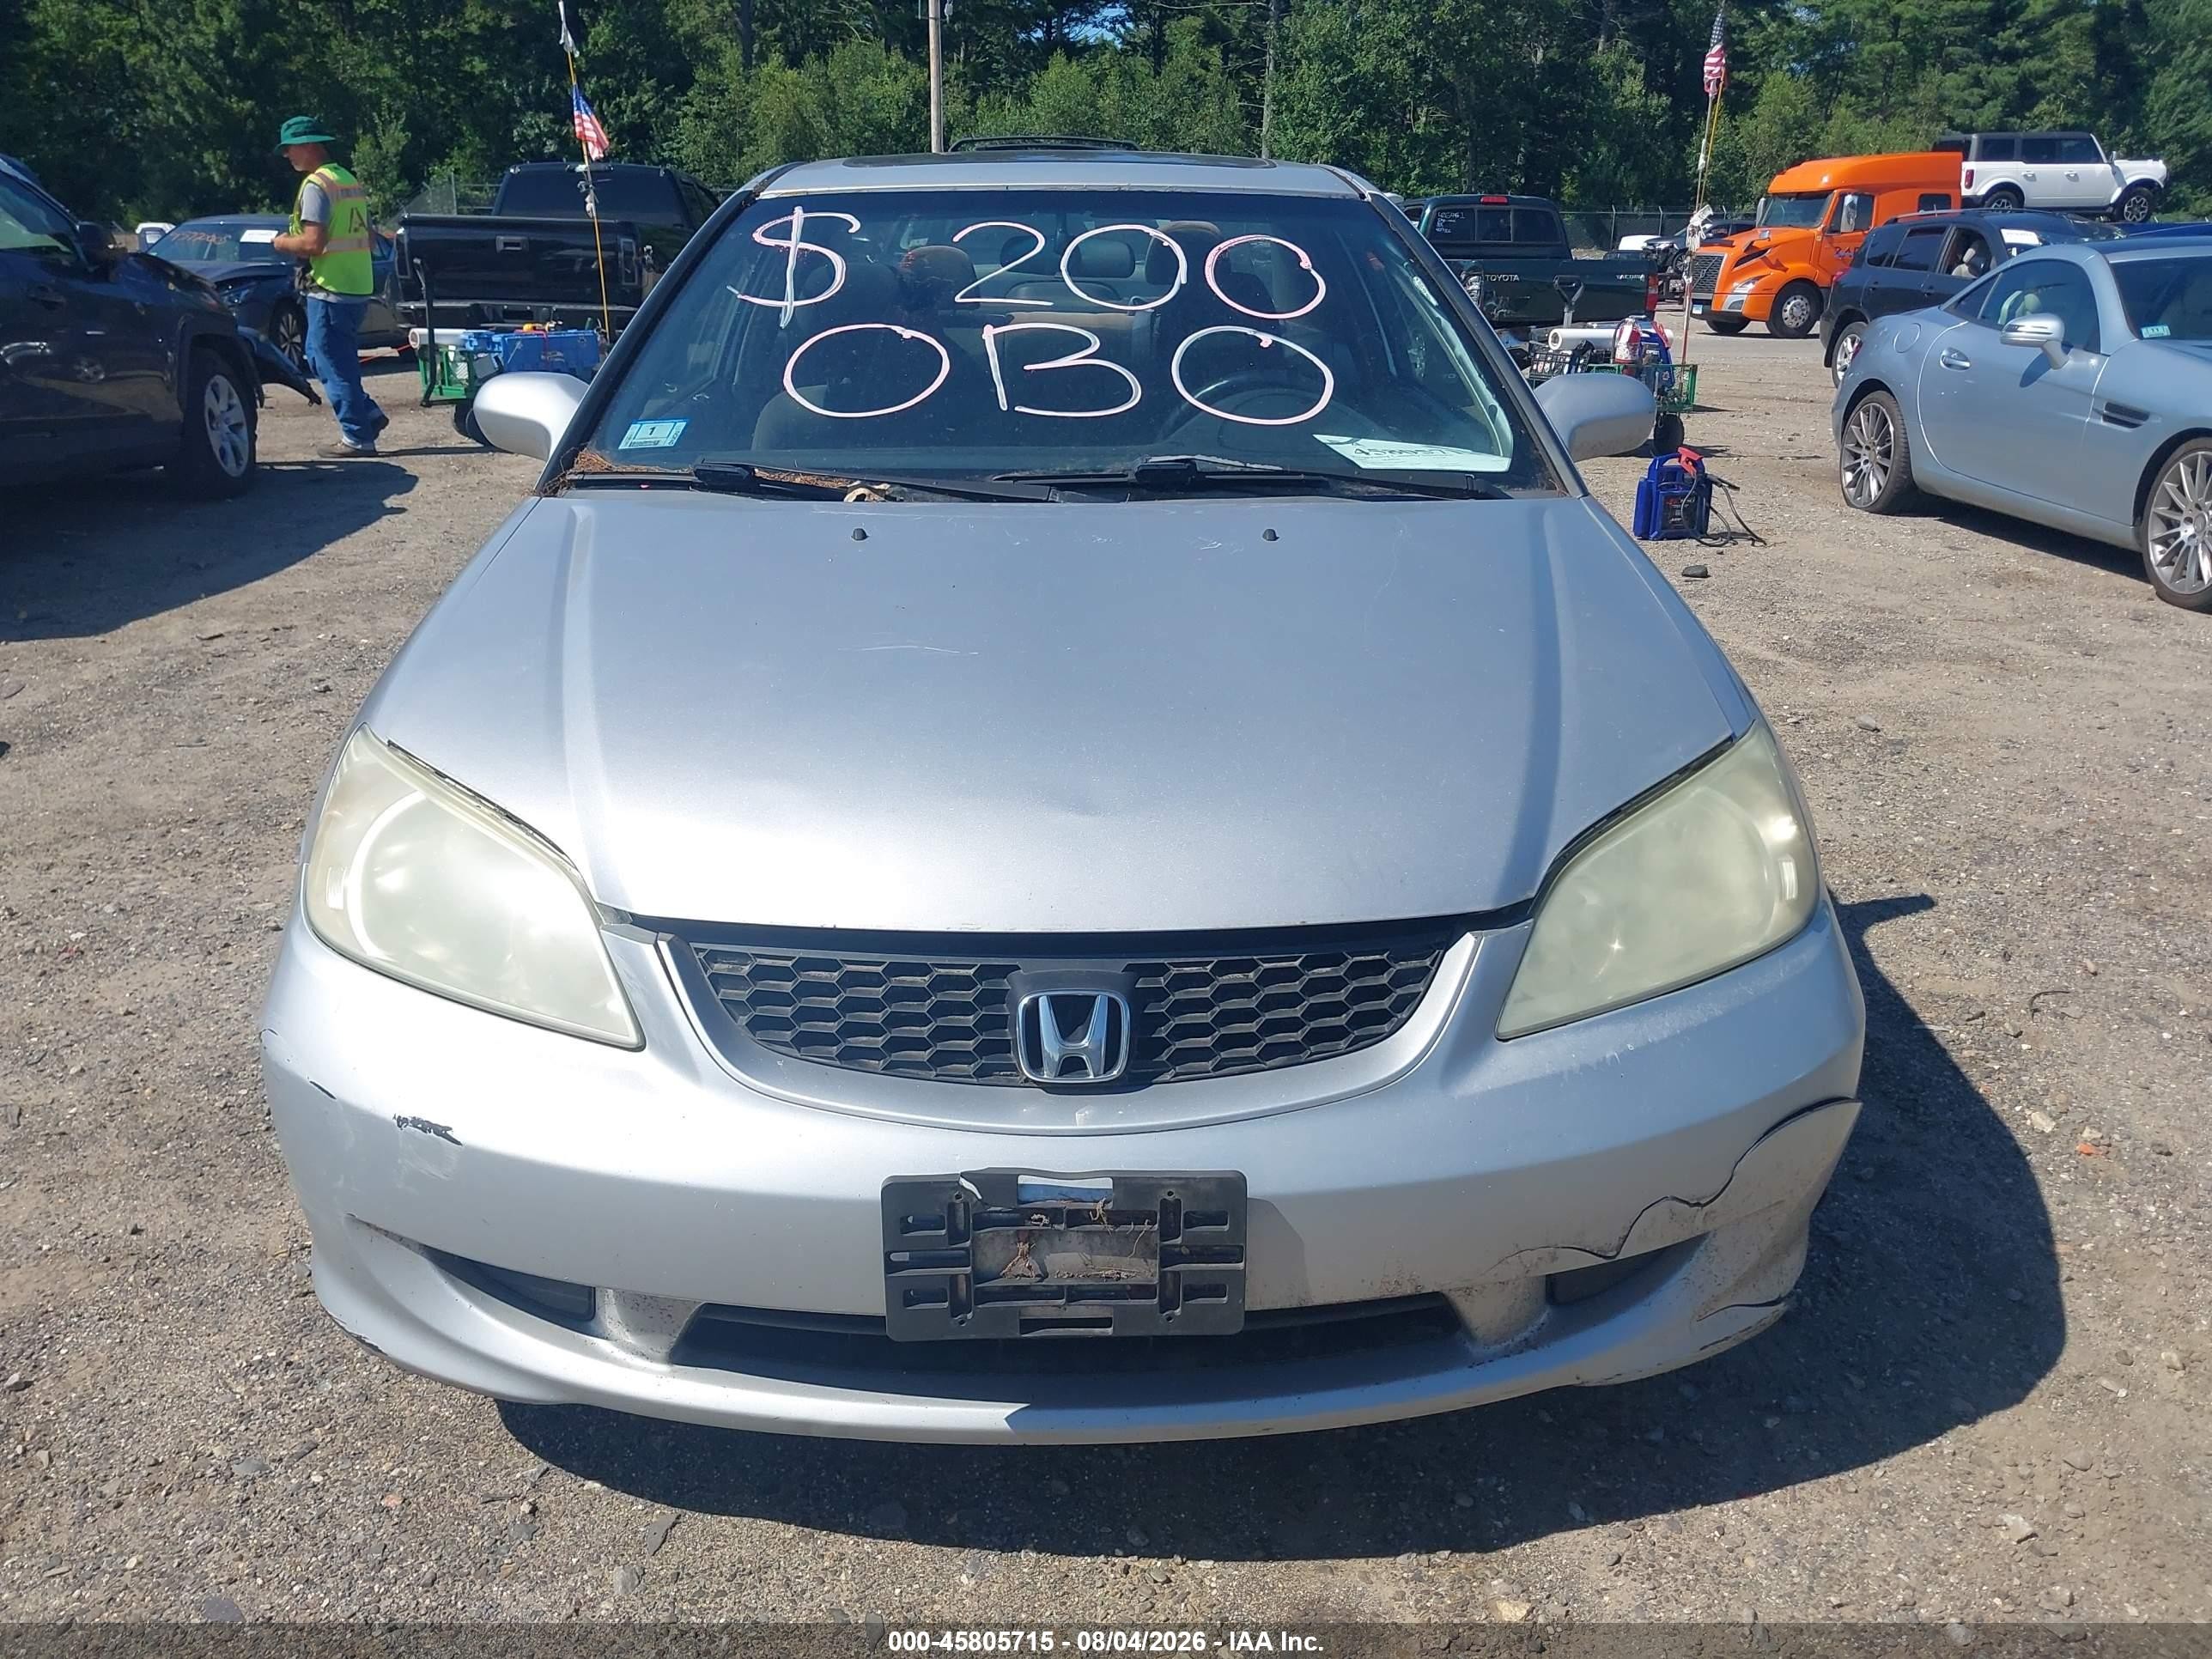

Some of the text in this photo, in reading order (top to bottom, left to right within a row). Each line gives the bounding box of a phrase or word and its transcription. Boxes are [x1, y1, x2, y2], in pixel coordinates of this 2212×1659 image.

[952, 222, 1328, 320] 200
[1485, 274, 1520, 283] TOYOTA
[782, 323, 1335, 426] OBO
